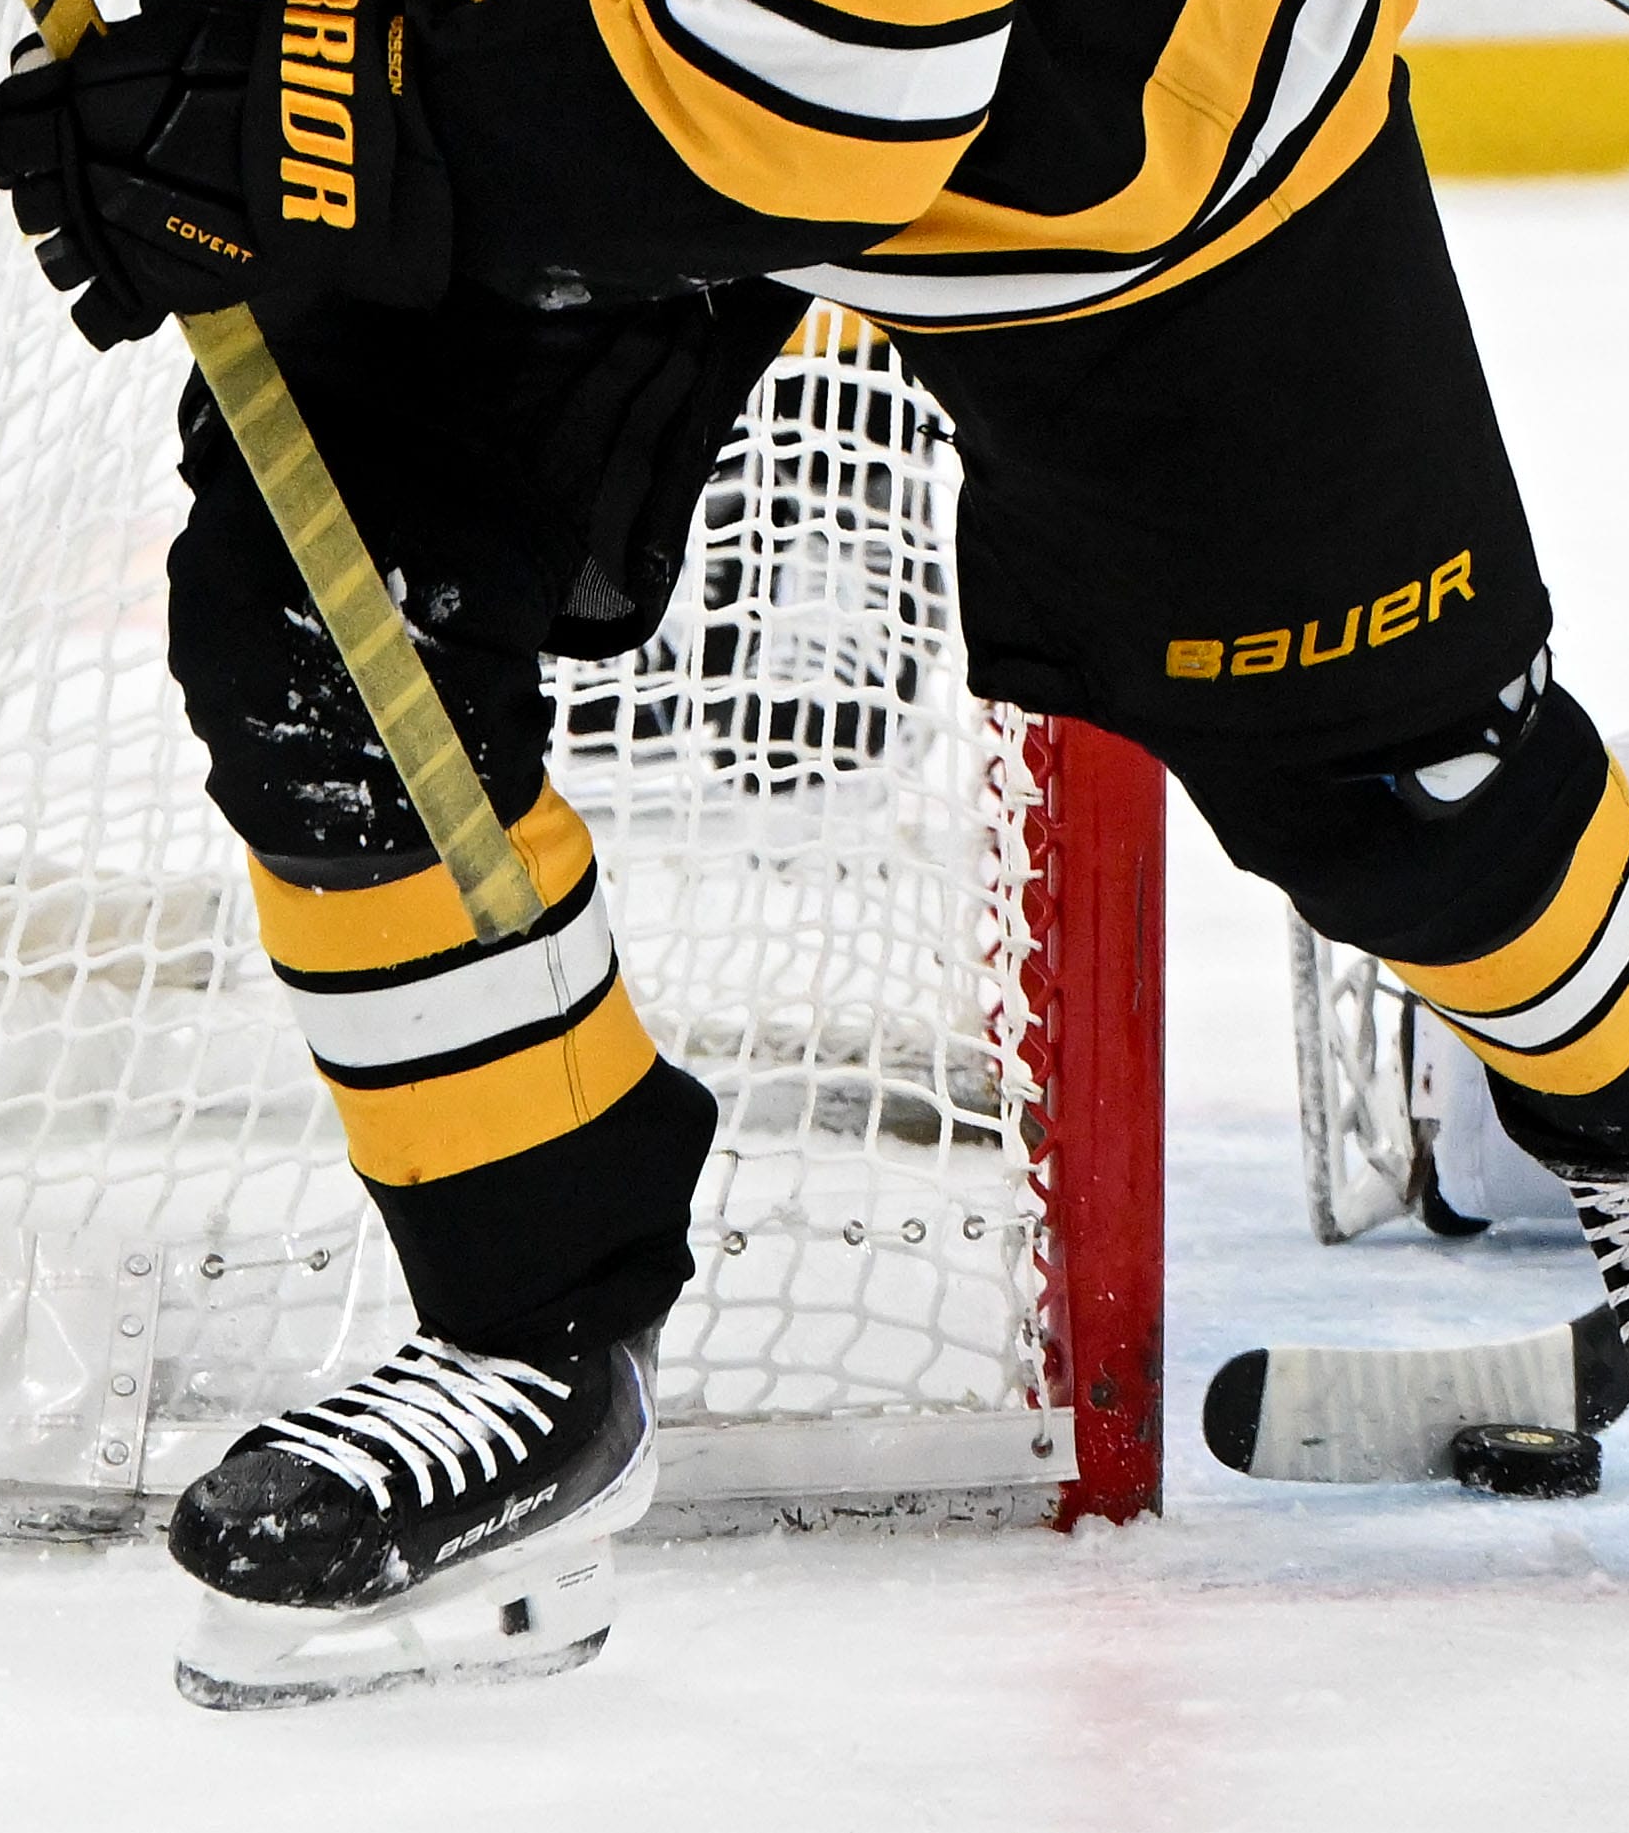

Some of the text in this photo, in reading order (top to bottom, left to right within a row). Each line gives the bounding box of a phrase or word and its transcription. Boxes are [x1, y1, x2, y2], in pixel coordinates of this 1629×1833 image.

[165, 214, 254, 266] COVERT
[1165, 548, 1476, 681] BAUER
[434, 1481, 559, 1565] BAUER
